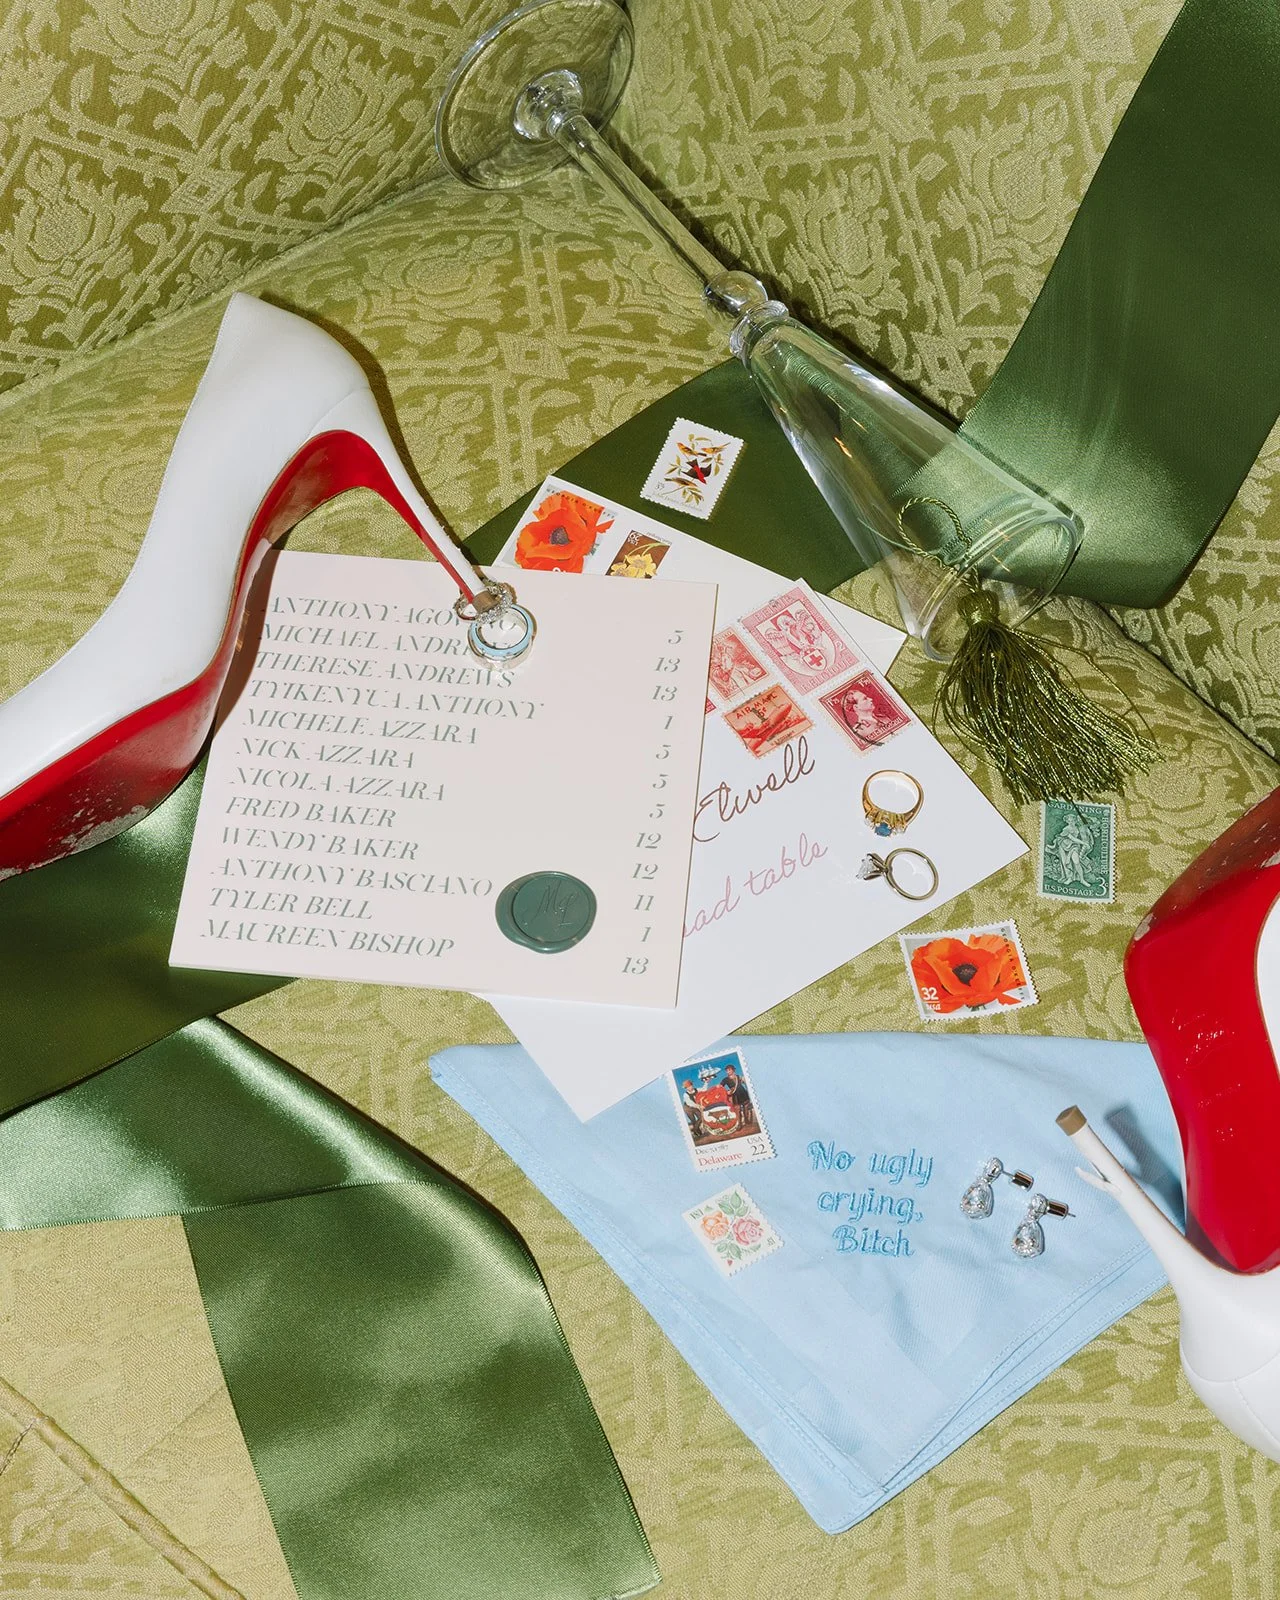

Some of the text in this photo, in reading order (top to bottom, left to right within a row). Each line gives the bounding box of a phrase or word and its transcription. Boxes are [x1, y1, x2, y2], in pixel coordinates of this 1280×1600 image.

[263, 596, 396, 621] ANTHONY
[668, 630, 684, 645] 5
[259, 623, 680, 672] MICHAEL ANDR 13
[255, 651, 677, 701] THERESE ANDREWS 13
[242, 708, 671, 760] MICHELE AZZARA 5
[405, 694, 544, 720] ANTHONY
[664, 715, 673, 730] 1
[735, 706, 756, 720] AIR
[236, 737, 669, 789] NICK AZZARA 5
[229, 767, 665, 819] NICOLA AZZARA 5
[225, 796, 661, 849] FRED BAKER 12
[1100, 817, 1109, 875] HORTICULTURE
[222, 826, 658, 880] WENDY BAKER 12
[744, 832, 828, 895] table
[210, 858, 654, 911] ANTHONY BASCIANO 11
[209, 887, 651, 942] TYLER BELL 1
[200, 919, 649, 975] MAUREEN BISHOP 13
[921, 987, 939, 1000] 32
[697, 1152, 743, 1168] Delaware
[746, 1135, 763, 1145] USA
[751, 1144, 768, 1157] 22
[807, 1140, 933, 1187] No ugly
[817, 1187, 924, 1225] crying,
[832, 1224, 915, 1258] Bitch
